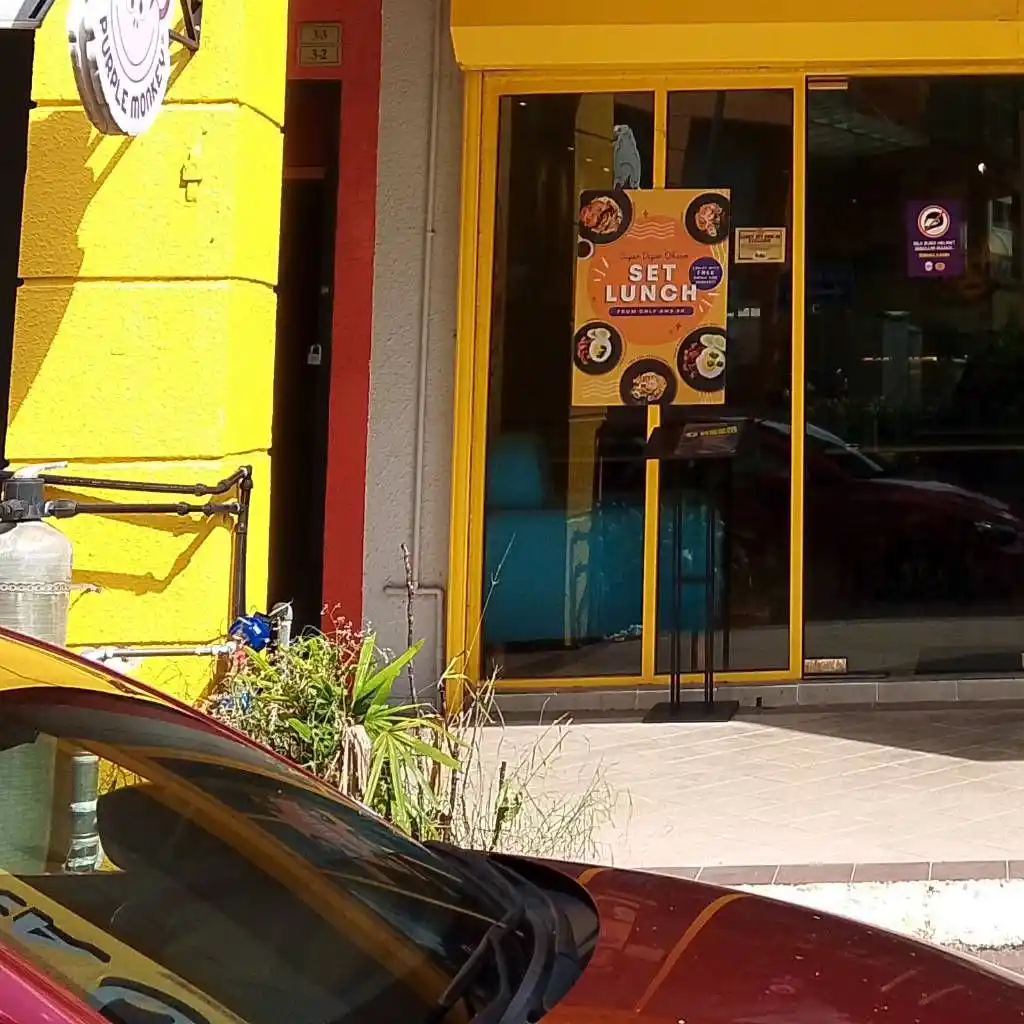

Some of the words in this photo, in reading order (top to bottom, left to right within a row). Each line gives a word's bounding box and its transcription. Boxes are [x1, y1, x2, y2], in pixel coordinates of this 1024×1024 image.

[99, 15, 129, 115] PURPLE
[629, 263, 677, 282] SET
[605, 283, 697, 303] LUNCH
